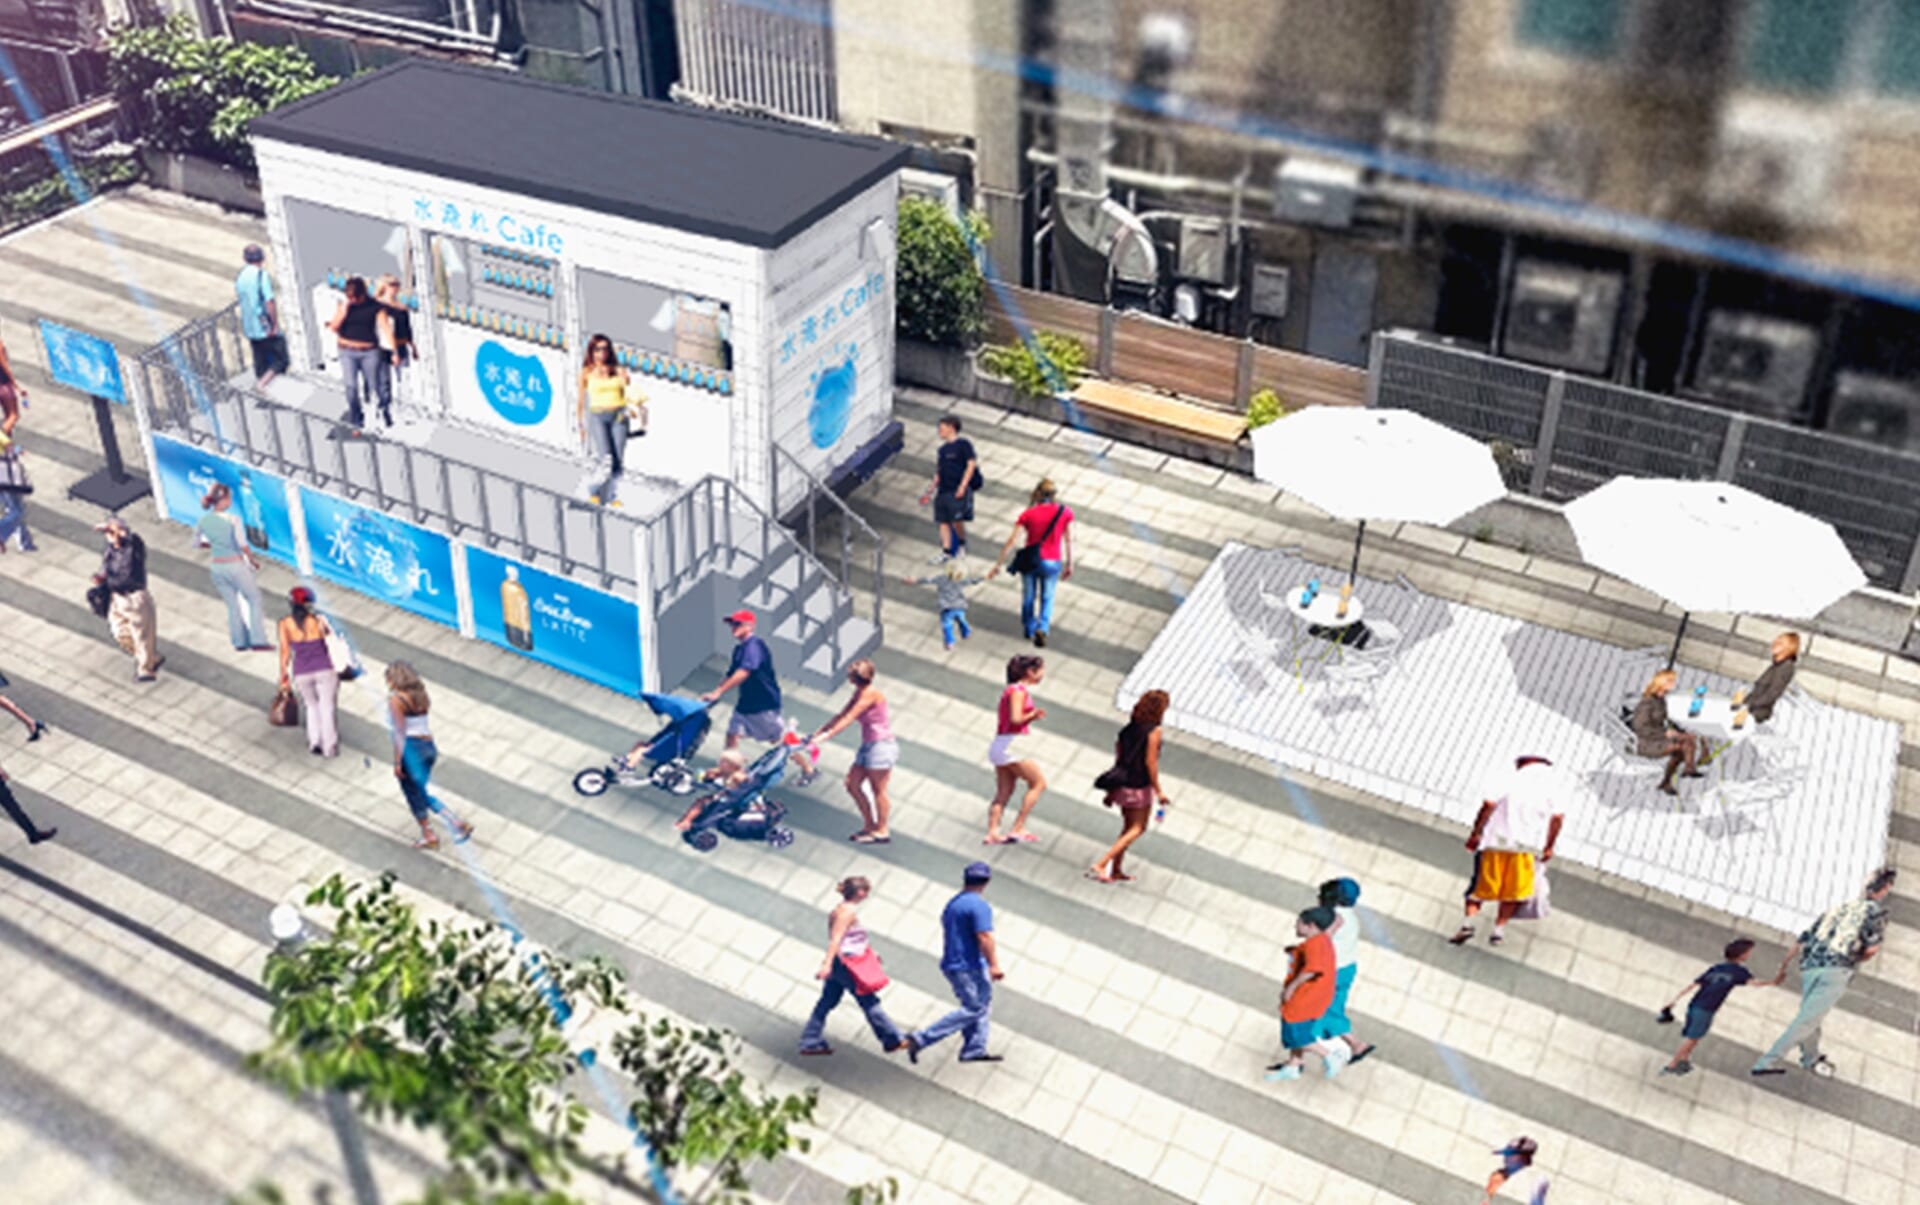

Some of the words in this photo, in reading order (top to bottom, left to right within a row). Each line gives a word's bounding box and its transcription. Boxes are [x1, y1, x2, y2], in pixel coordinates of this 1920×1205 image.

[497, 215, 563, 253] Cafe
[839, 271, 884, 317] Cafe
[493, 384, 535, 411] Cafe
